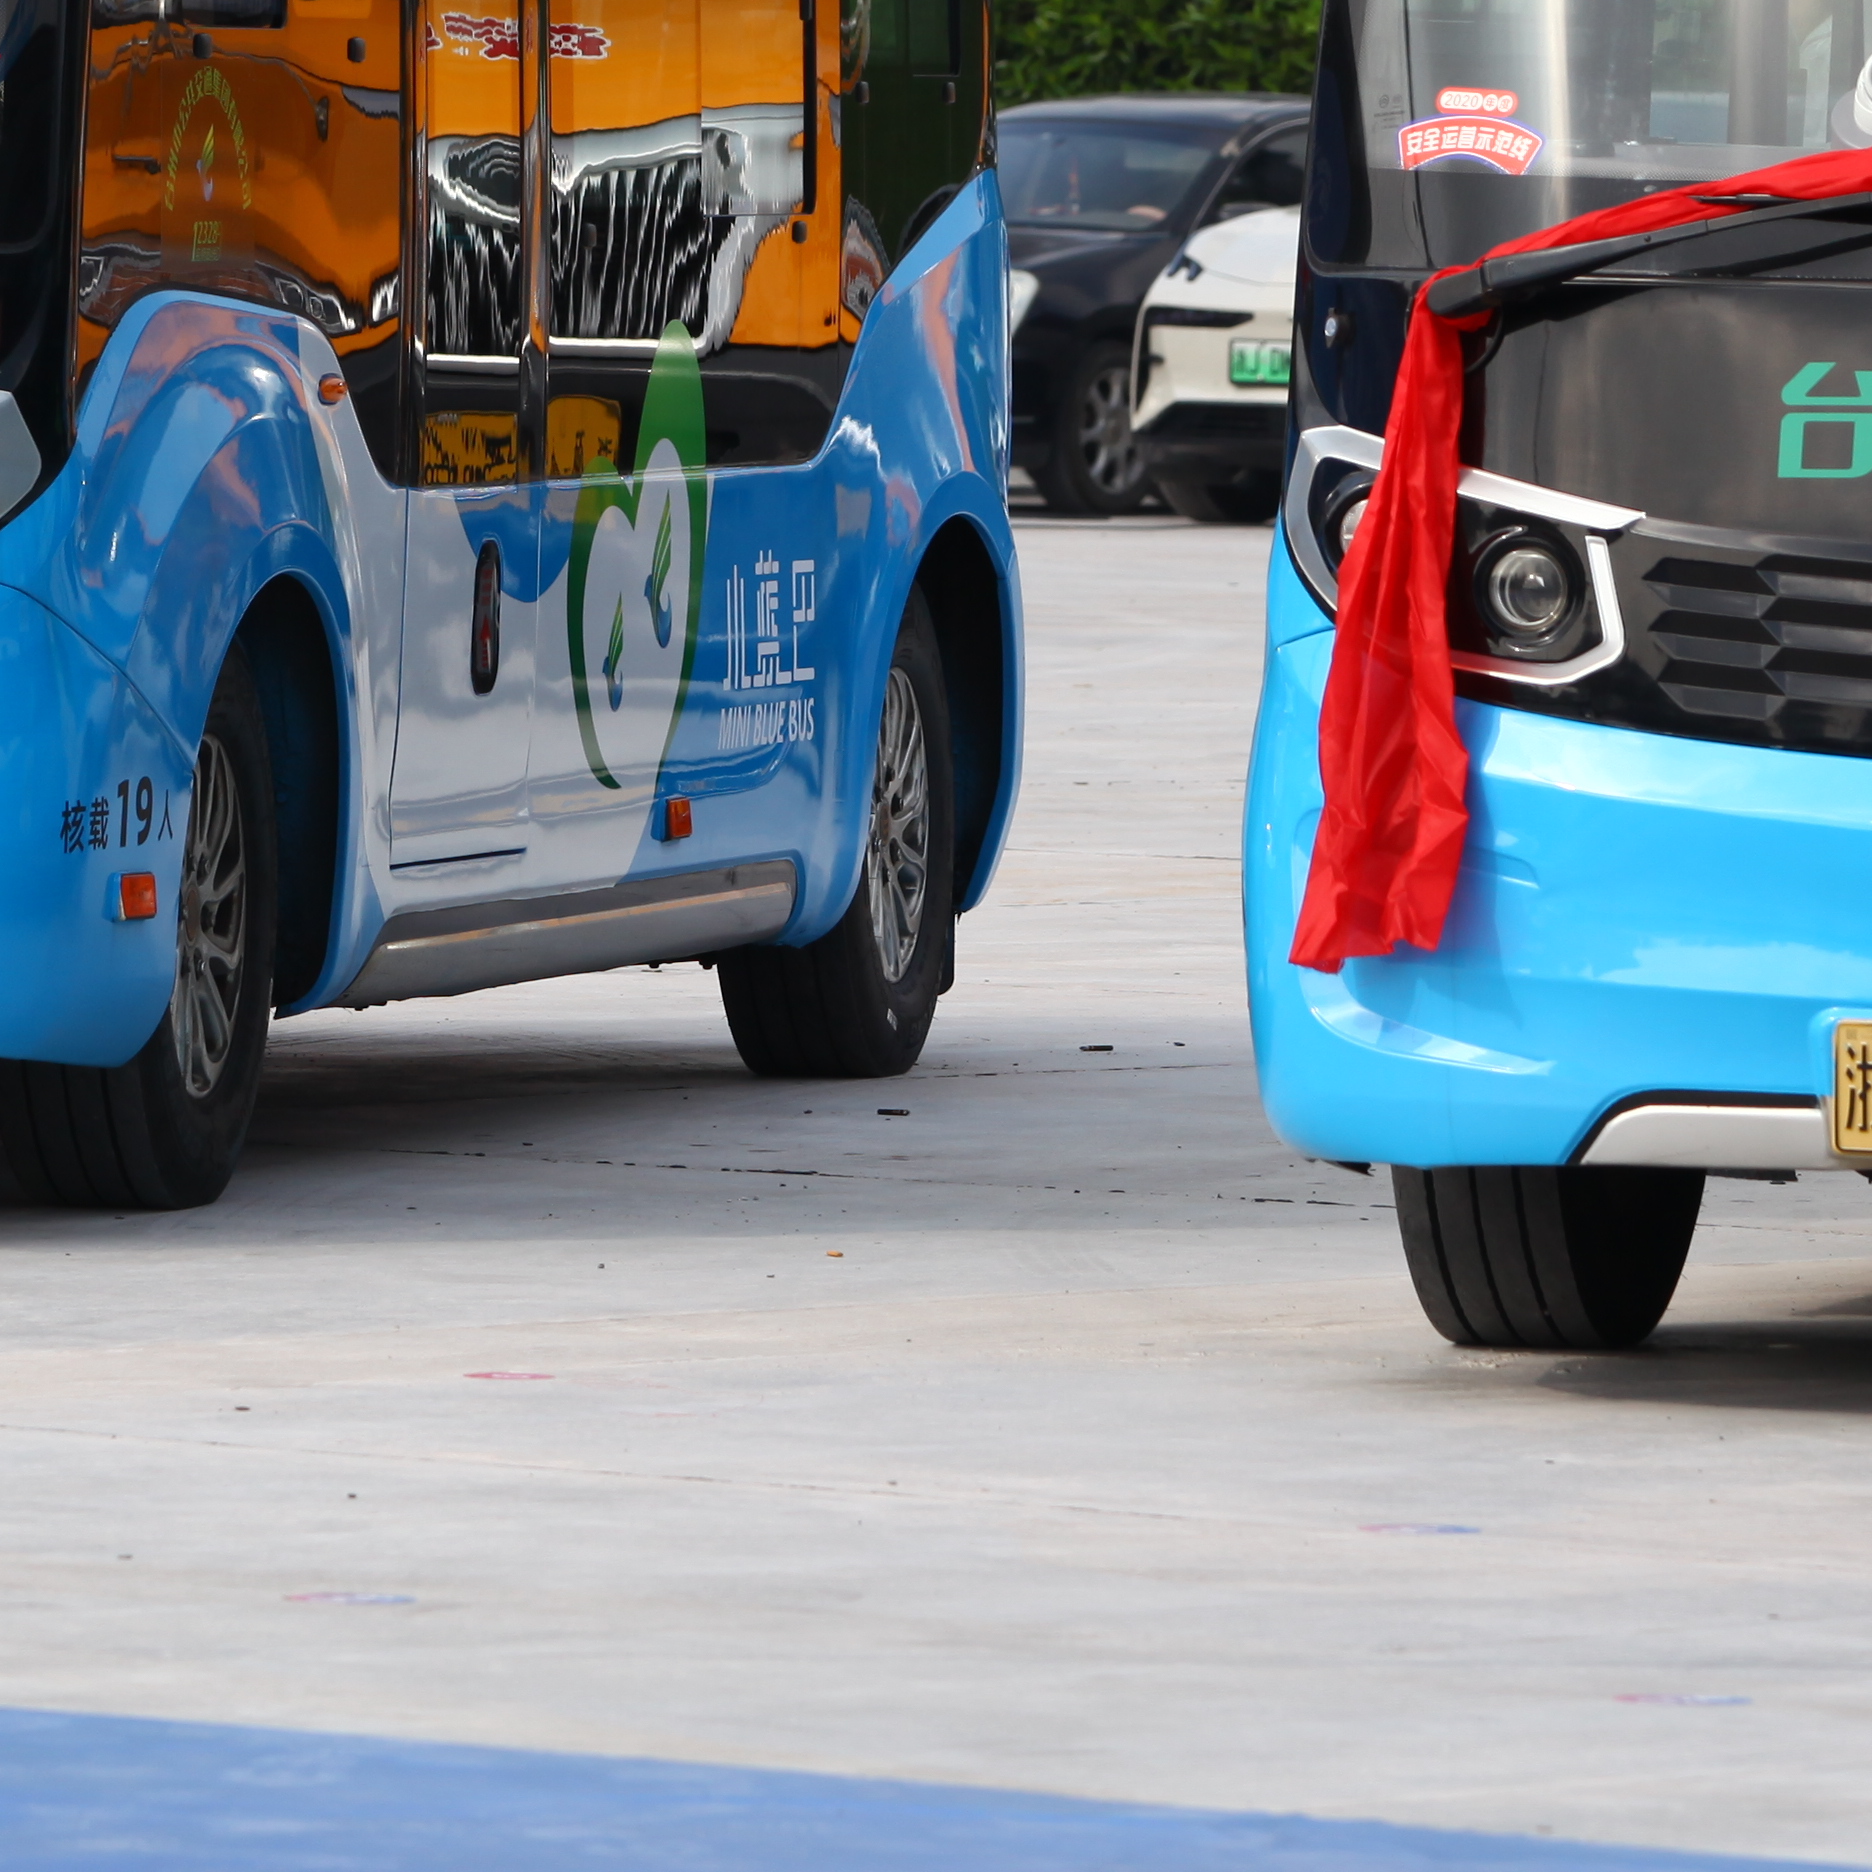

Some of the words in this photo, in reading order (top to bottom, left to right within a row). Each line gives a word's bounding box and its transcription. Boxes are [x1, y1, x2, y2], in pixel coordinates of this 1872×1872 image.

[1406, 125, 1533, 162] 安全运营示范线
[718, 705, 751, 750] MINI
[753, 700, 787, 746] BLUE
[788, 697, 815, 742] BUS
